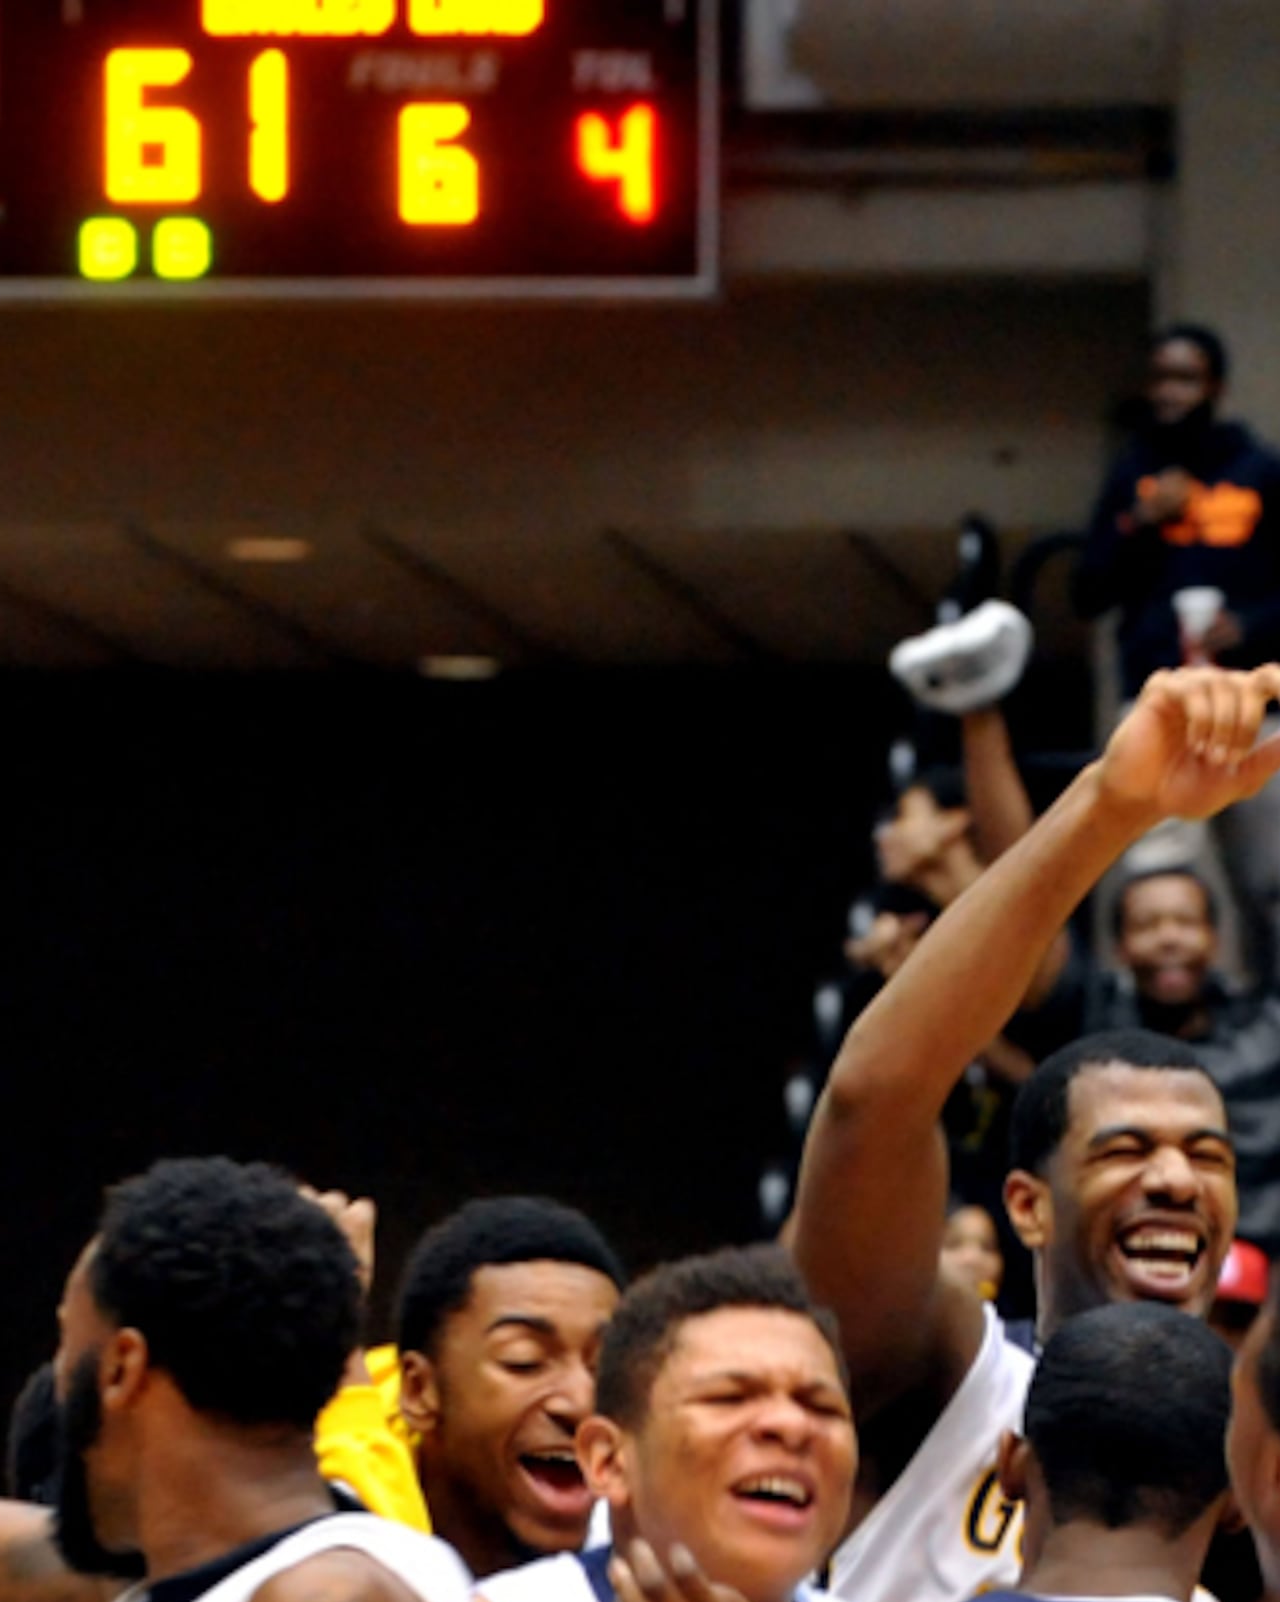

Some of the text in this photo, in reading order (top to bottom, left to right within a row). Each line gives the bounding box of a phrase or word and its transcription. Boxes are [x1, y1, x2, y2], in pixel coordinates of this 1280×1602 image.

[104, 48, 288, 204] 61
[398, 102, 478, 225] 6
[577, 104, 654, 221] 4
